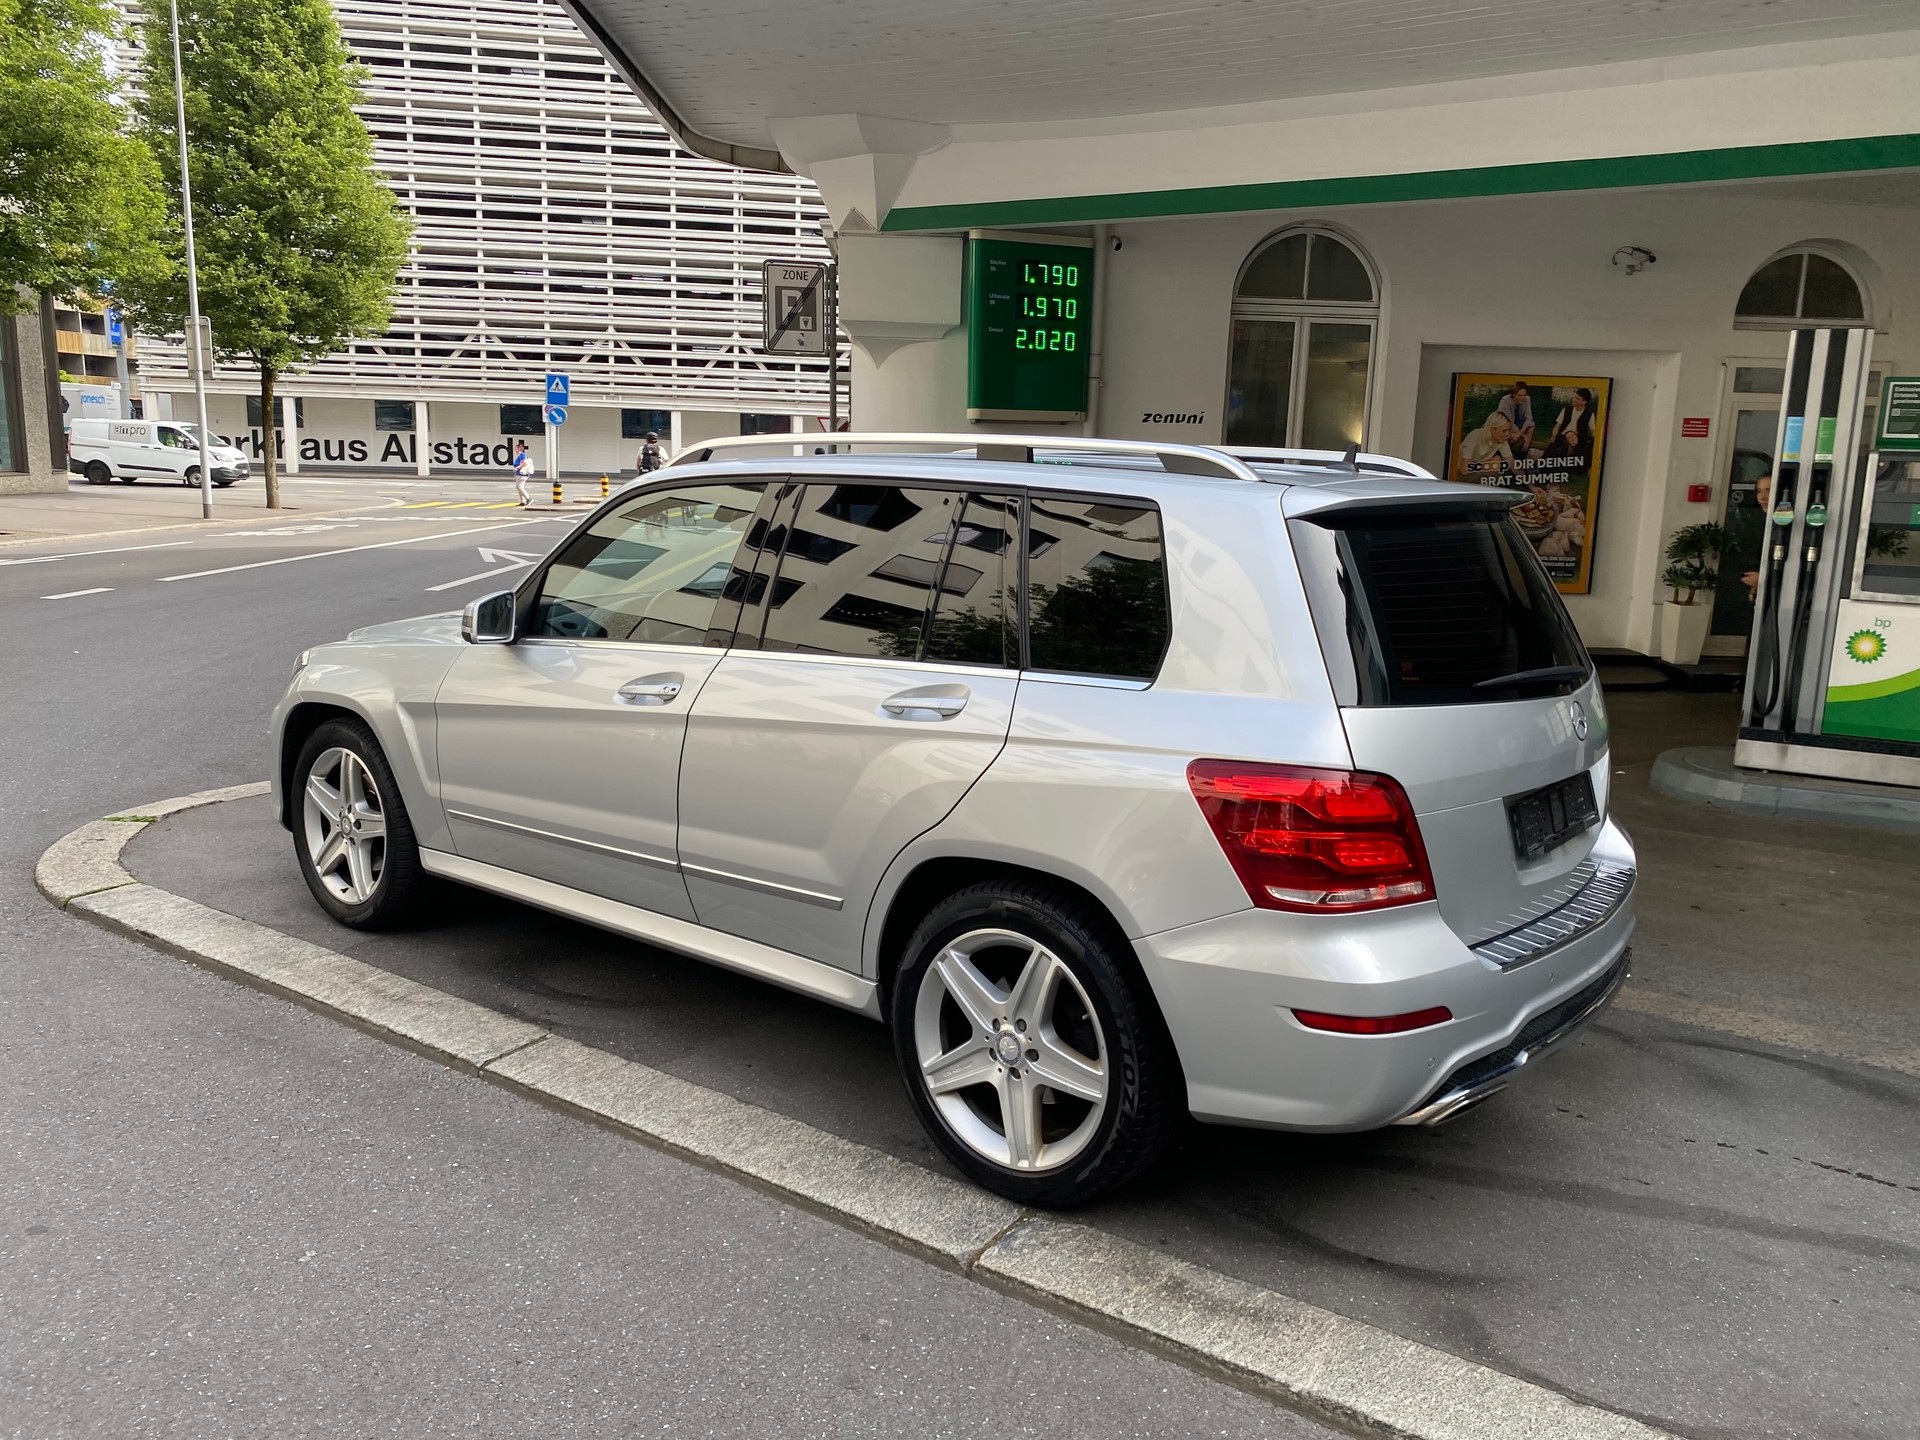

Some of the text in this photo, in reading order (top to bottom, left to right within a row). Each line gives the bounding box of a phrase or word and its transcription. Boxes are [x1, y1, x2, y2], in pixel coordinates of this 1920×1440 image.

[782, 270, 809, 281] ZONE
[1024, 264, 1078, 287] 1.790
[1023, 297, 1077, 319] 1.970
[1015, 328, 1076, 351] 2.020
[1141, 411, 1205, 424] zenuni
[1467, 456, 1584, 474] scoop DIR DEINEN
[1480, 473, 1569, 487] BRAT SUMMER
[1874, 616, 1892, 630] bp
